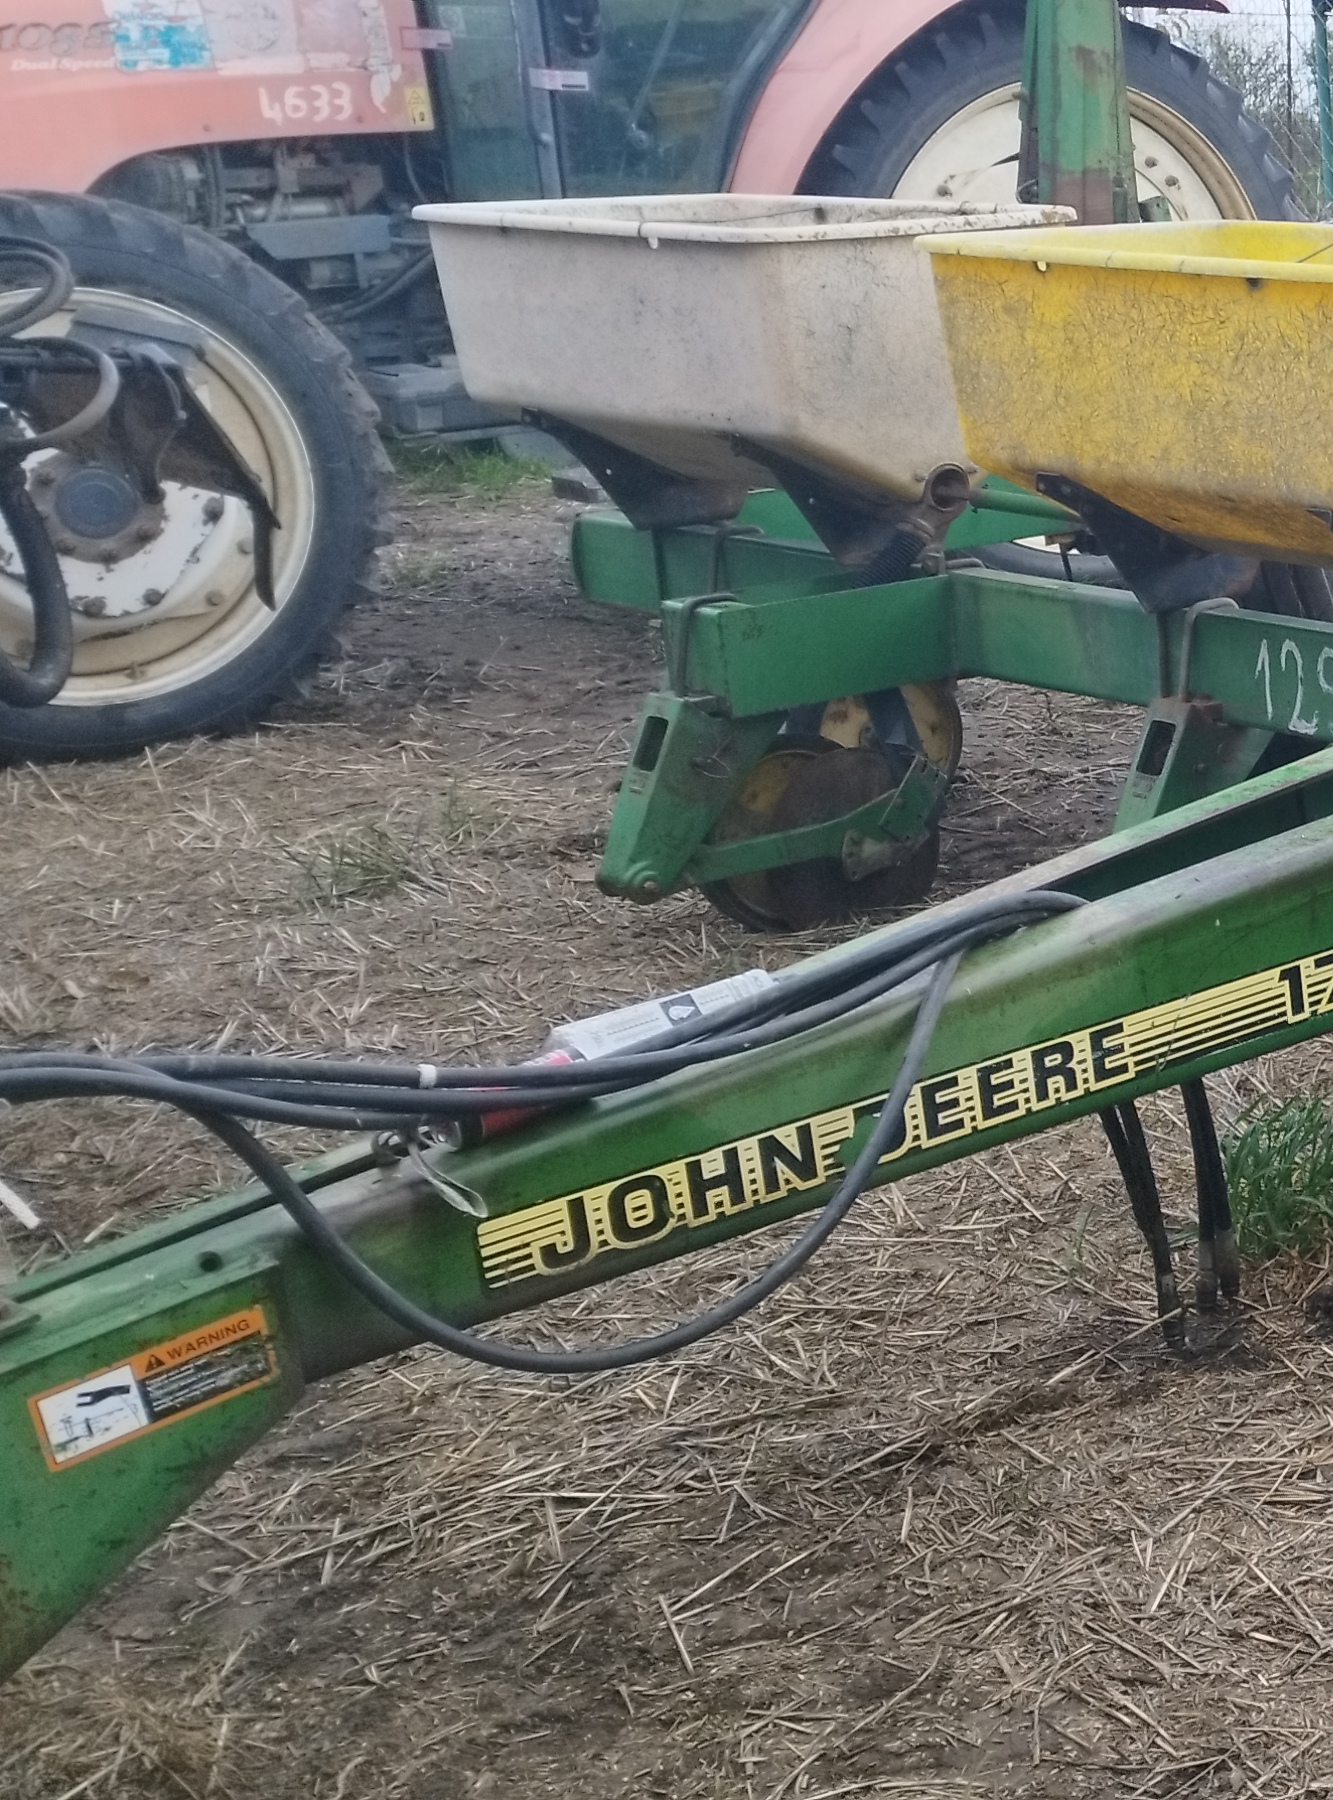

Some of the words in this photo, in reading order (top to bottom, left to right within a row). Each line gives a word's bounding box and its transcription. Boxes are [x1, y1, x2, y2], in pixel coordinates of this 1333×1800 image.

[258, 81, 353, 126] 4633
[536, 1120, 822, 1272] JOHN
[166, 1319, 251, 1360] WARNING
